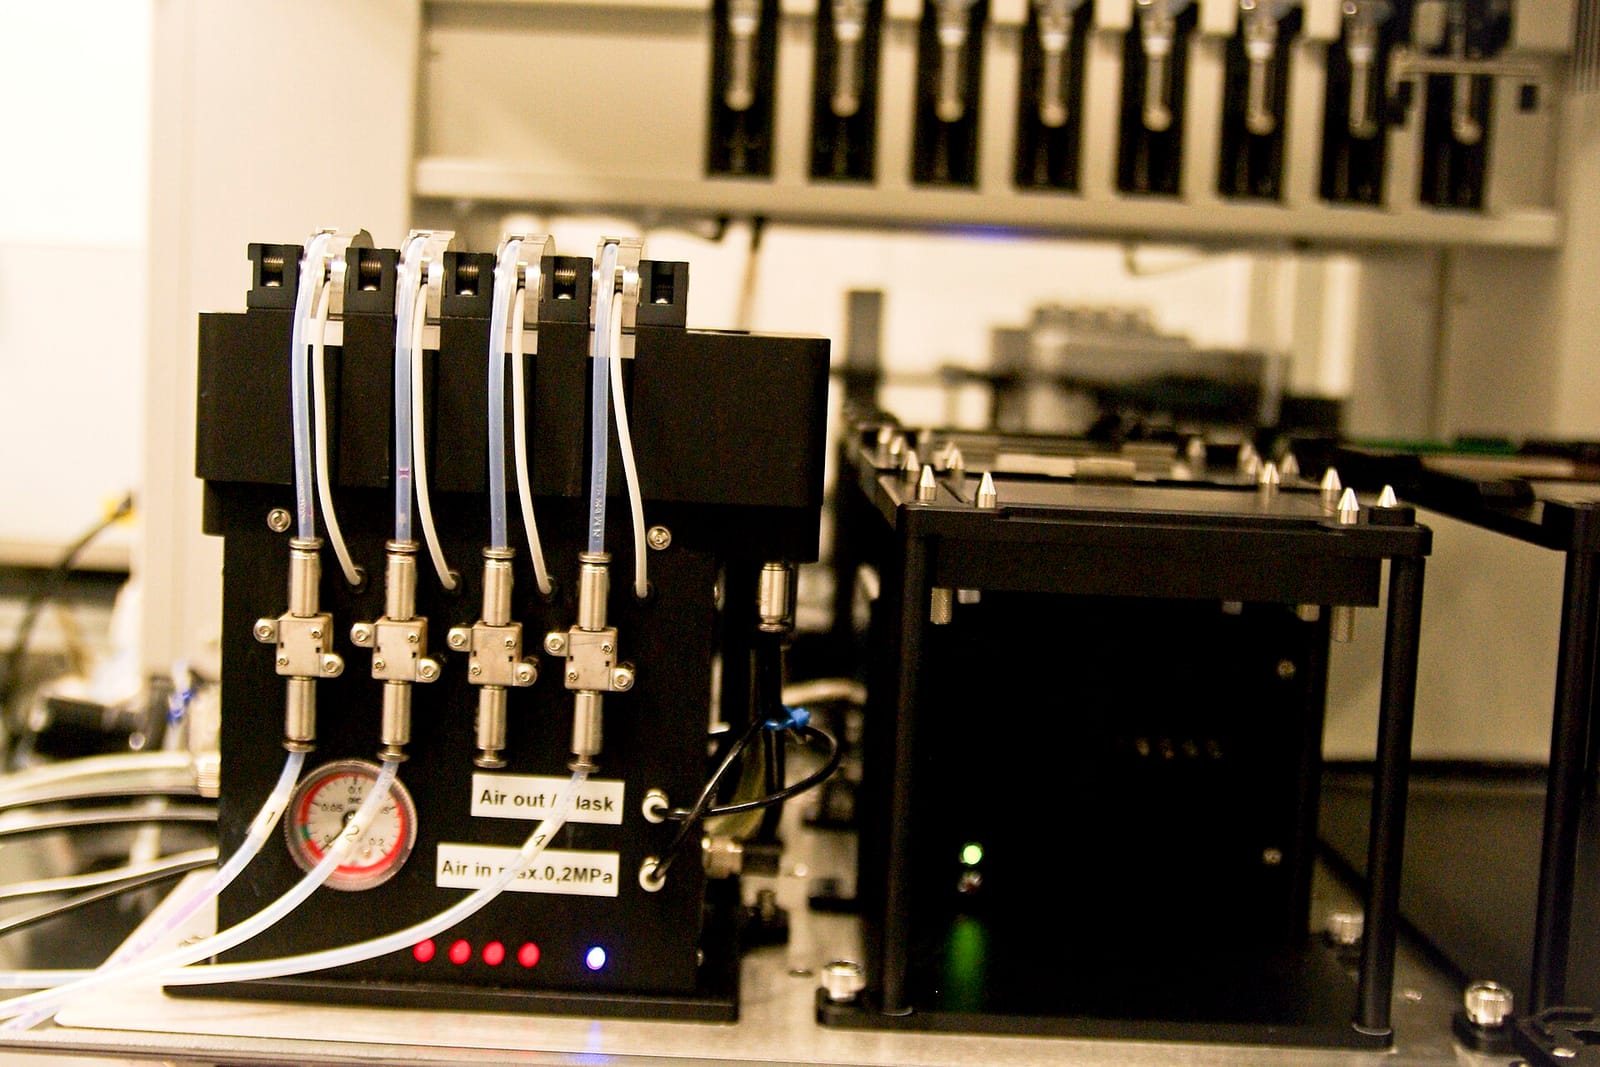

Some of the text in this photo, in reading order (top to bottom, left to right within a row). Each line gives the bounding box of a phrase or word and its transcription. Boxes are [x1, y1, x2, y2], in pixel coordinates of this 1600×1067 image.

[479, 789, 615, 812] Air out / lask
[345, 825, 360, 843] 2
[441, 860, 468, 876] Air
[475, 861, 491, 877] in
